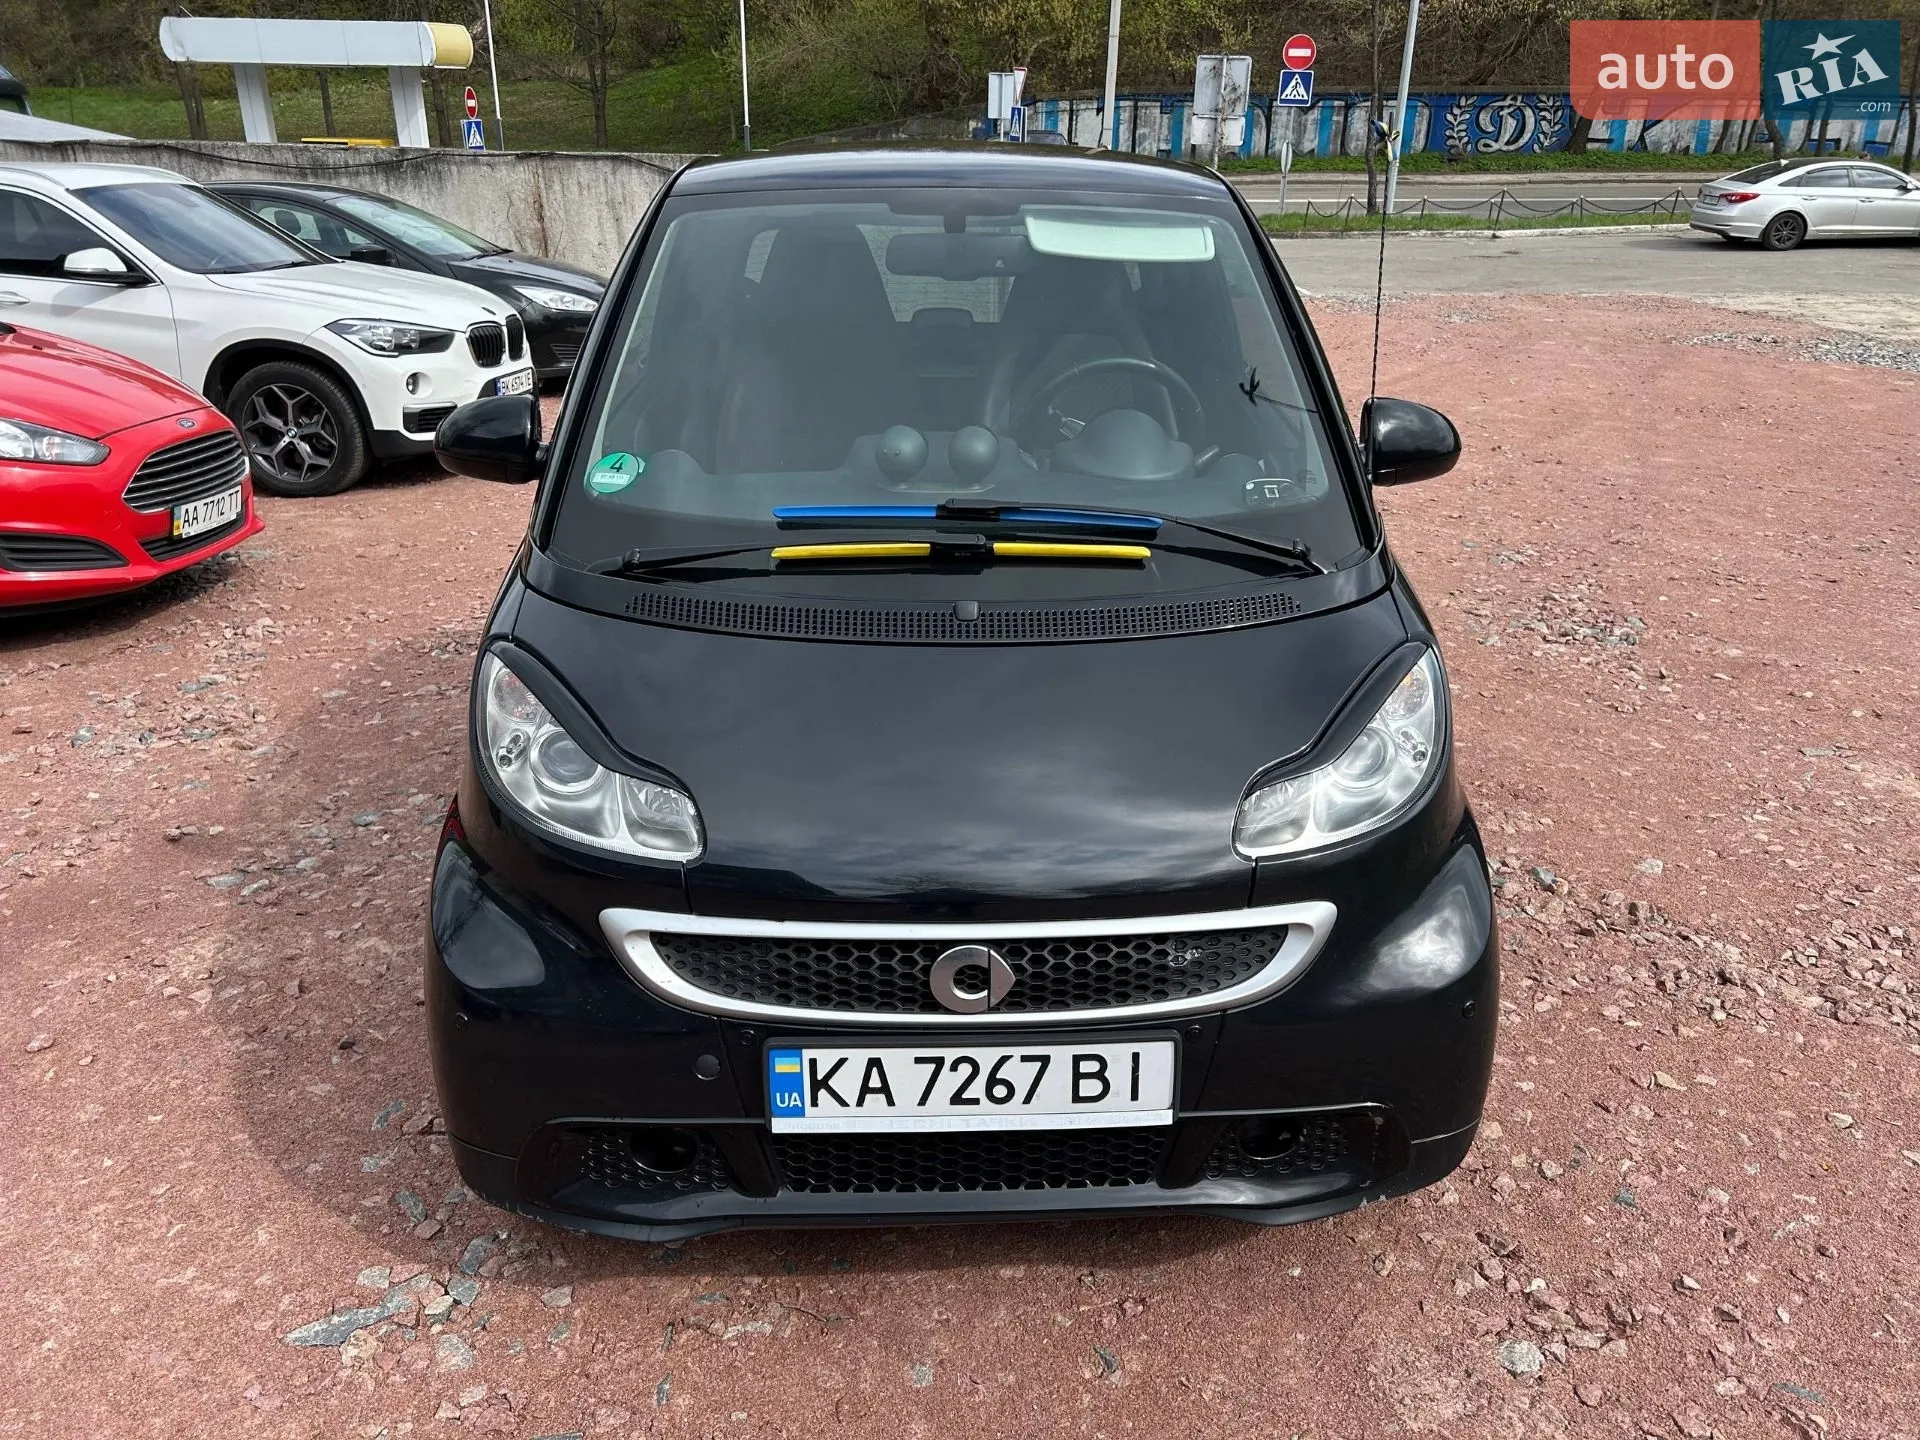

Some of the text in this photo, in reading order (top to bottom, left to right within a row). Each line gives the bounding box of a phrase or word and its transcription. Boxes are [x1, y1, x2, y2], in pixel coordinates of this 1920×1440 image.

[610, 454, 626, 473] 4
[182, 505, 199, 529] AA
[203, 496, 226, 523] 7712
[228, 489, 240, 512] TT
[808, 1052, 1140, 1108] KA 7267 BI
[775, 1092, 803, 1108] UA
